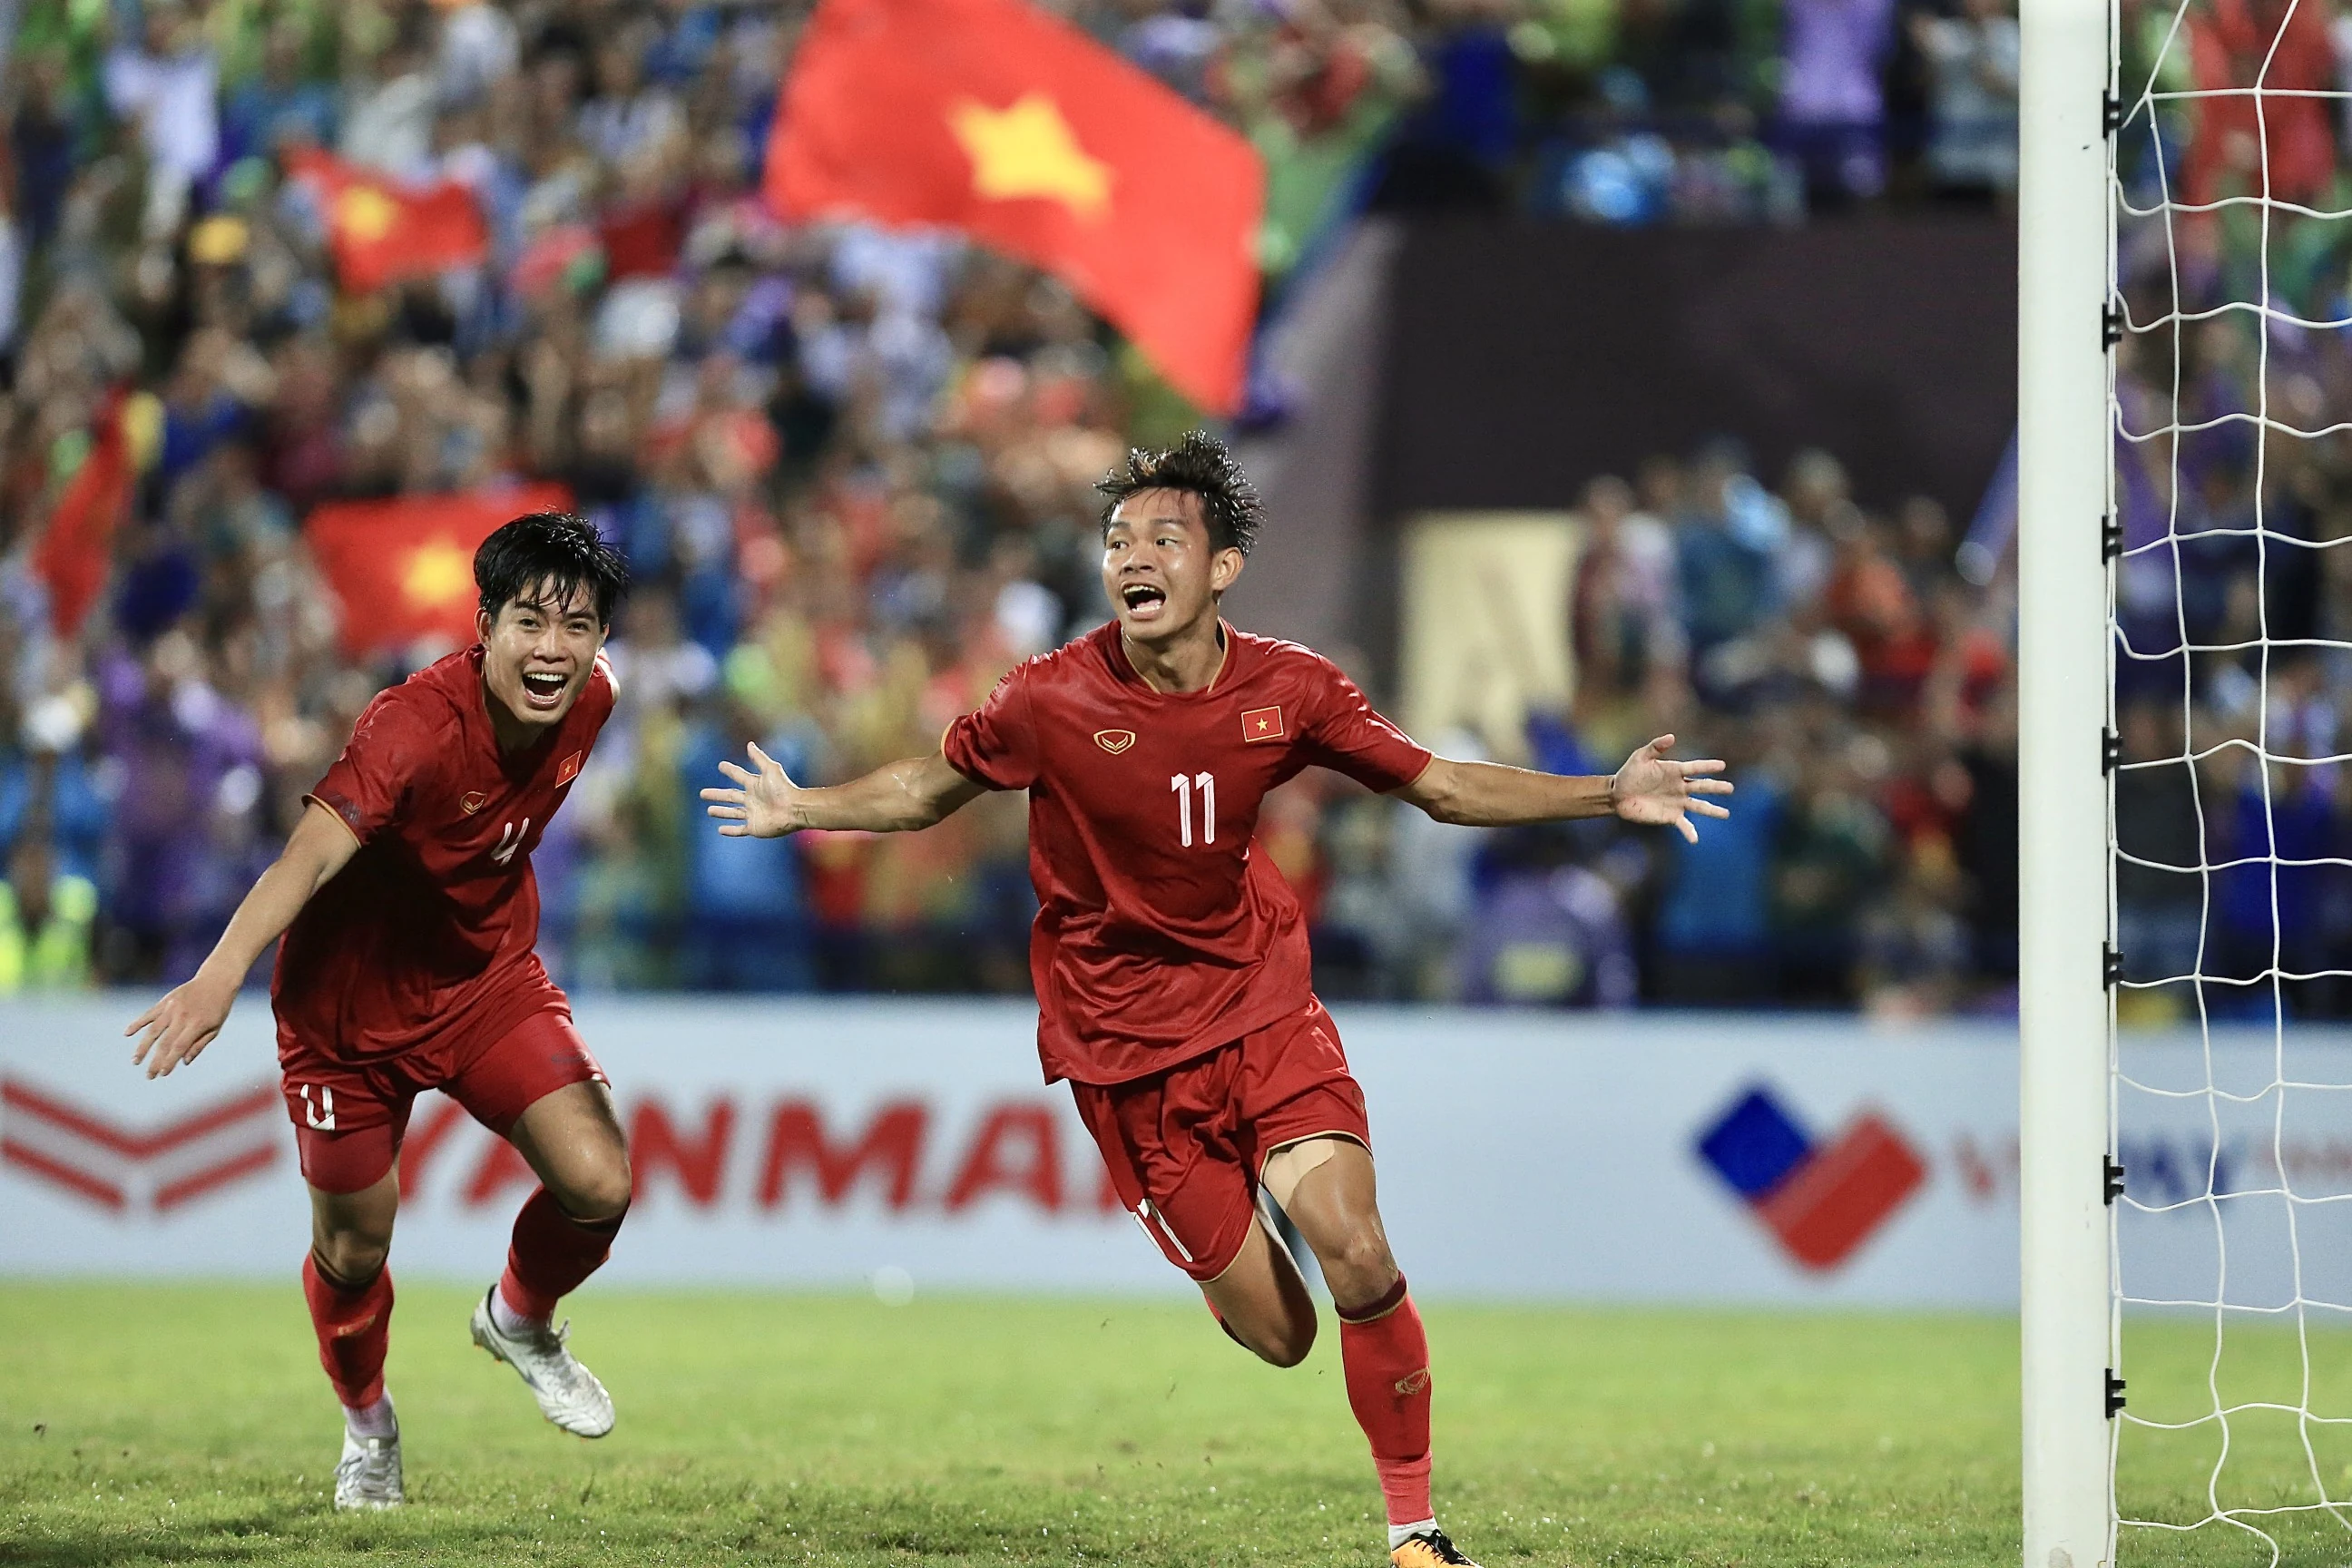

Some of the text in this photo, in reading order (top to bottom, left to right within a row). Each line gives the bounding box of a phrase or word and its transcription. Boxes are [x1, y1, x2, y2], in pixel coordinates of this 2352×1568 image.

[490, 817, 530, 866] 4
[1171, 770, 1215, 848] 11
[397, 1093, 1127, 1218] YNMA
